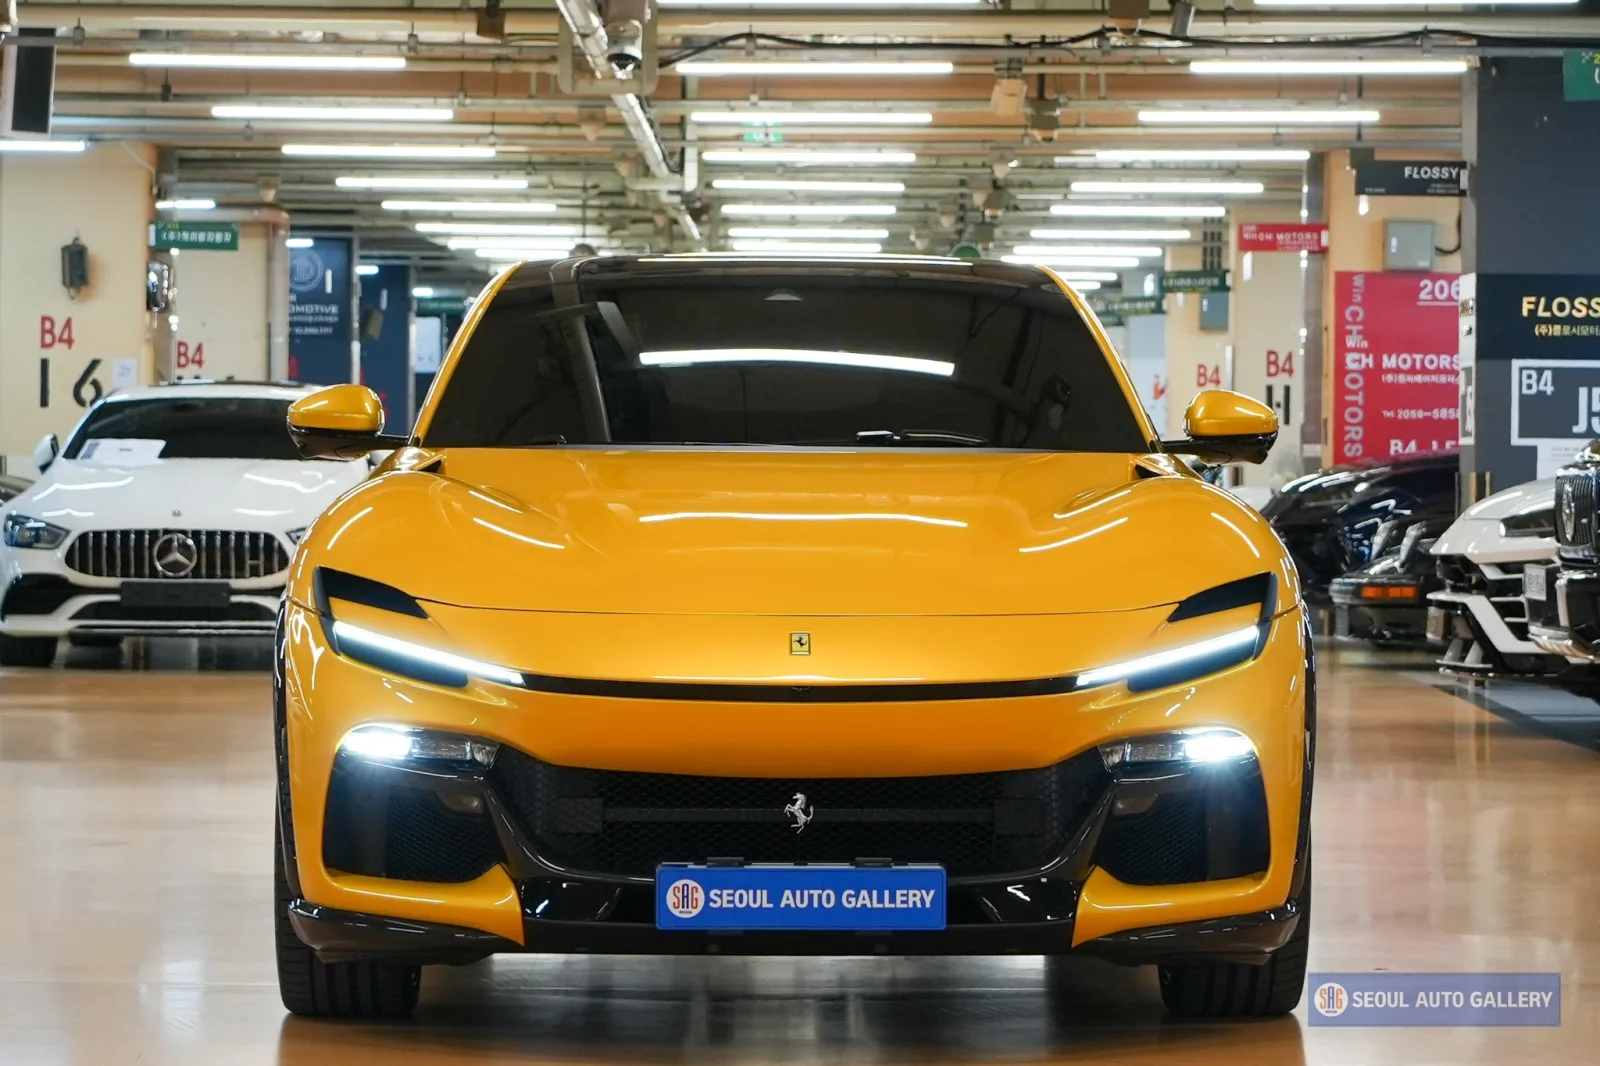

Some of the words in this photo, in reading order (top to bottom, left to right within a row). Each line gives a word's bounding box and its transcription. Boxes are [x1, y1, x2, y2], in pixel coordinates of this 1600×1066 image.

[1404, 166, 1459, 179] FLOSSY
[1522, 296, 1600, 318] FLOSS
[41, 316, 74, 349] B4
[1534, 324, 1600, 337] (주)플로시모터
[177, 341, 205, 368] B4
[1266, 351, 1294, 377] B4
[1197, 364, 1221, 388] B4
[1521, 369, 1554, 395] B4
[673, 883, 698, 909] SAG
[709, 889, 773, 908] SEOUL
[780, 889, 835, 908] AUTO
[841, 889, 935, 908] GALLERY
